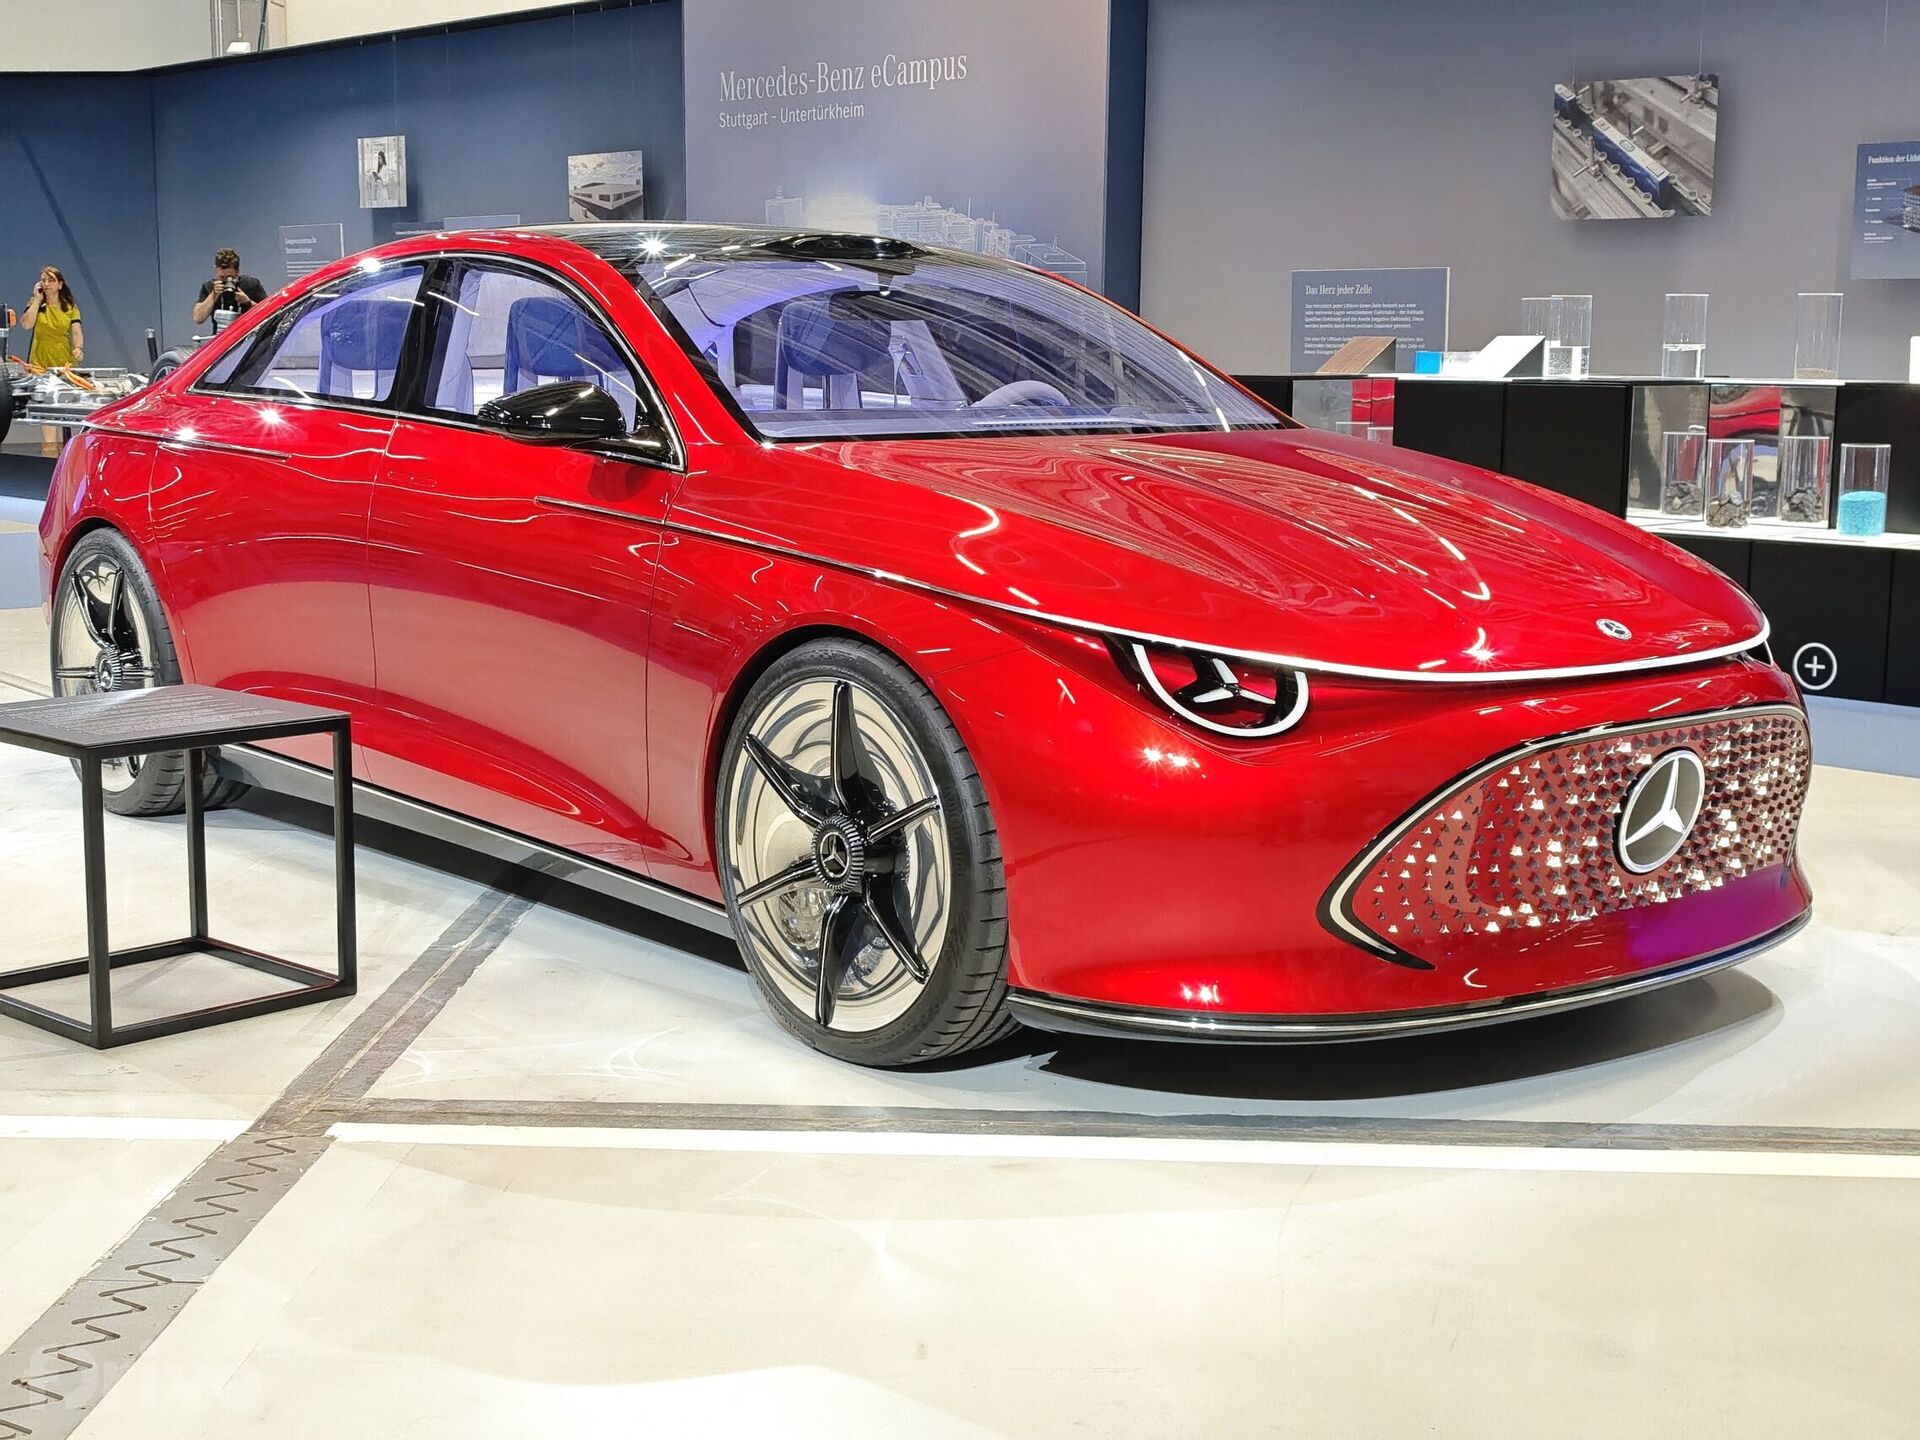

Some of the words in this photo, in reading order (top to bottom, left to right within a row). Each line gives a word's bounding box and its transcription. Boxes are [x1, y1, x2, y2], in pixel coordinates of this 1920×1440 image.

[719, 62, 865, 102] Mercedes-Benz
[870, 53, 969, 90] eCampus
[718, 109, 768, 130] Stuttgart
[780, 102, 865, 124] Untertürkheim
[1305, 284, 1319, 295] Das
[1319, 284, 1336, 295] Herz
[1336, 284, 1355, 297] jeder
[1355, 284, 1373, 295] Zelle
